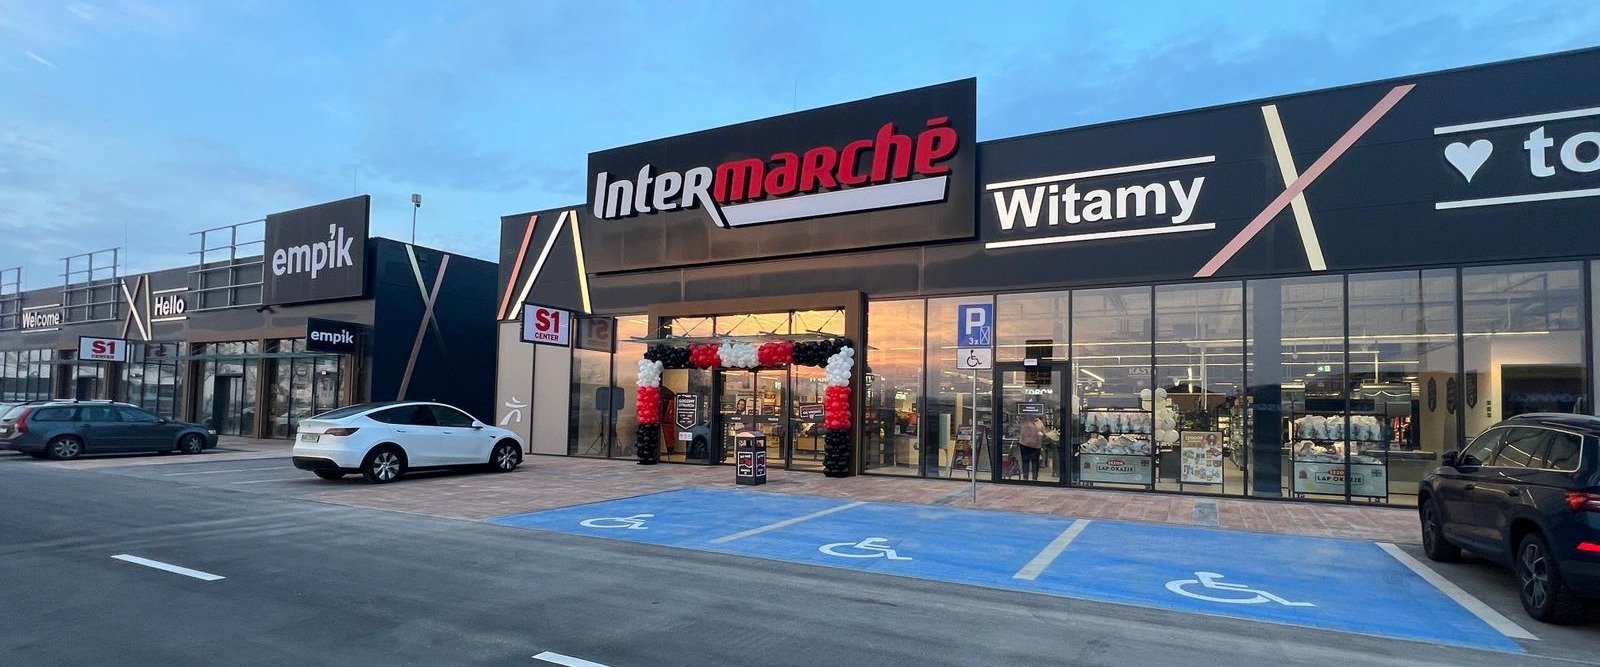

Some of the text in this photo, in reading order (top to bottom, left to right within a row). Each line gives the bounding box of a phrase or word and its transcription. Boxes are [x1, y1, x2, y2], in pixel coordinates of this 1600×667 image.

[1523, 125, 1600, 178] to
[593, 116, 957, 227] Intermarché
[993, 176, 1206, 230] Witamy
[272, 223, 354, 279] empik
[154, 294, 185, 316] Hello
[22, 312, 60, 328] Welcome
[535, 308, 560, 334] S1
[965, 307, 986, 335] P
[91, 340, 116, 355] S1
[311, 329, 354, 345] empik
[534, 332, 559, 341] CENTER
